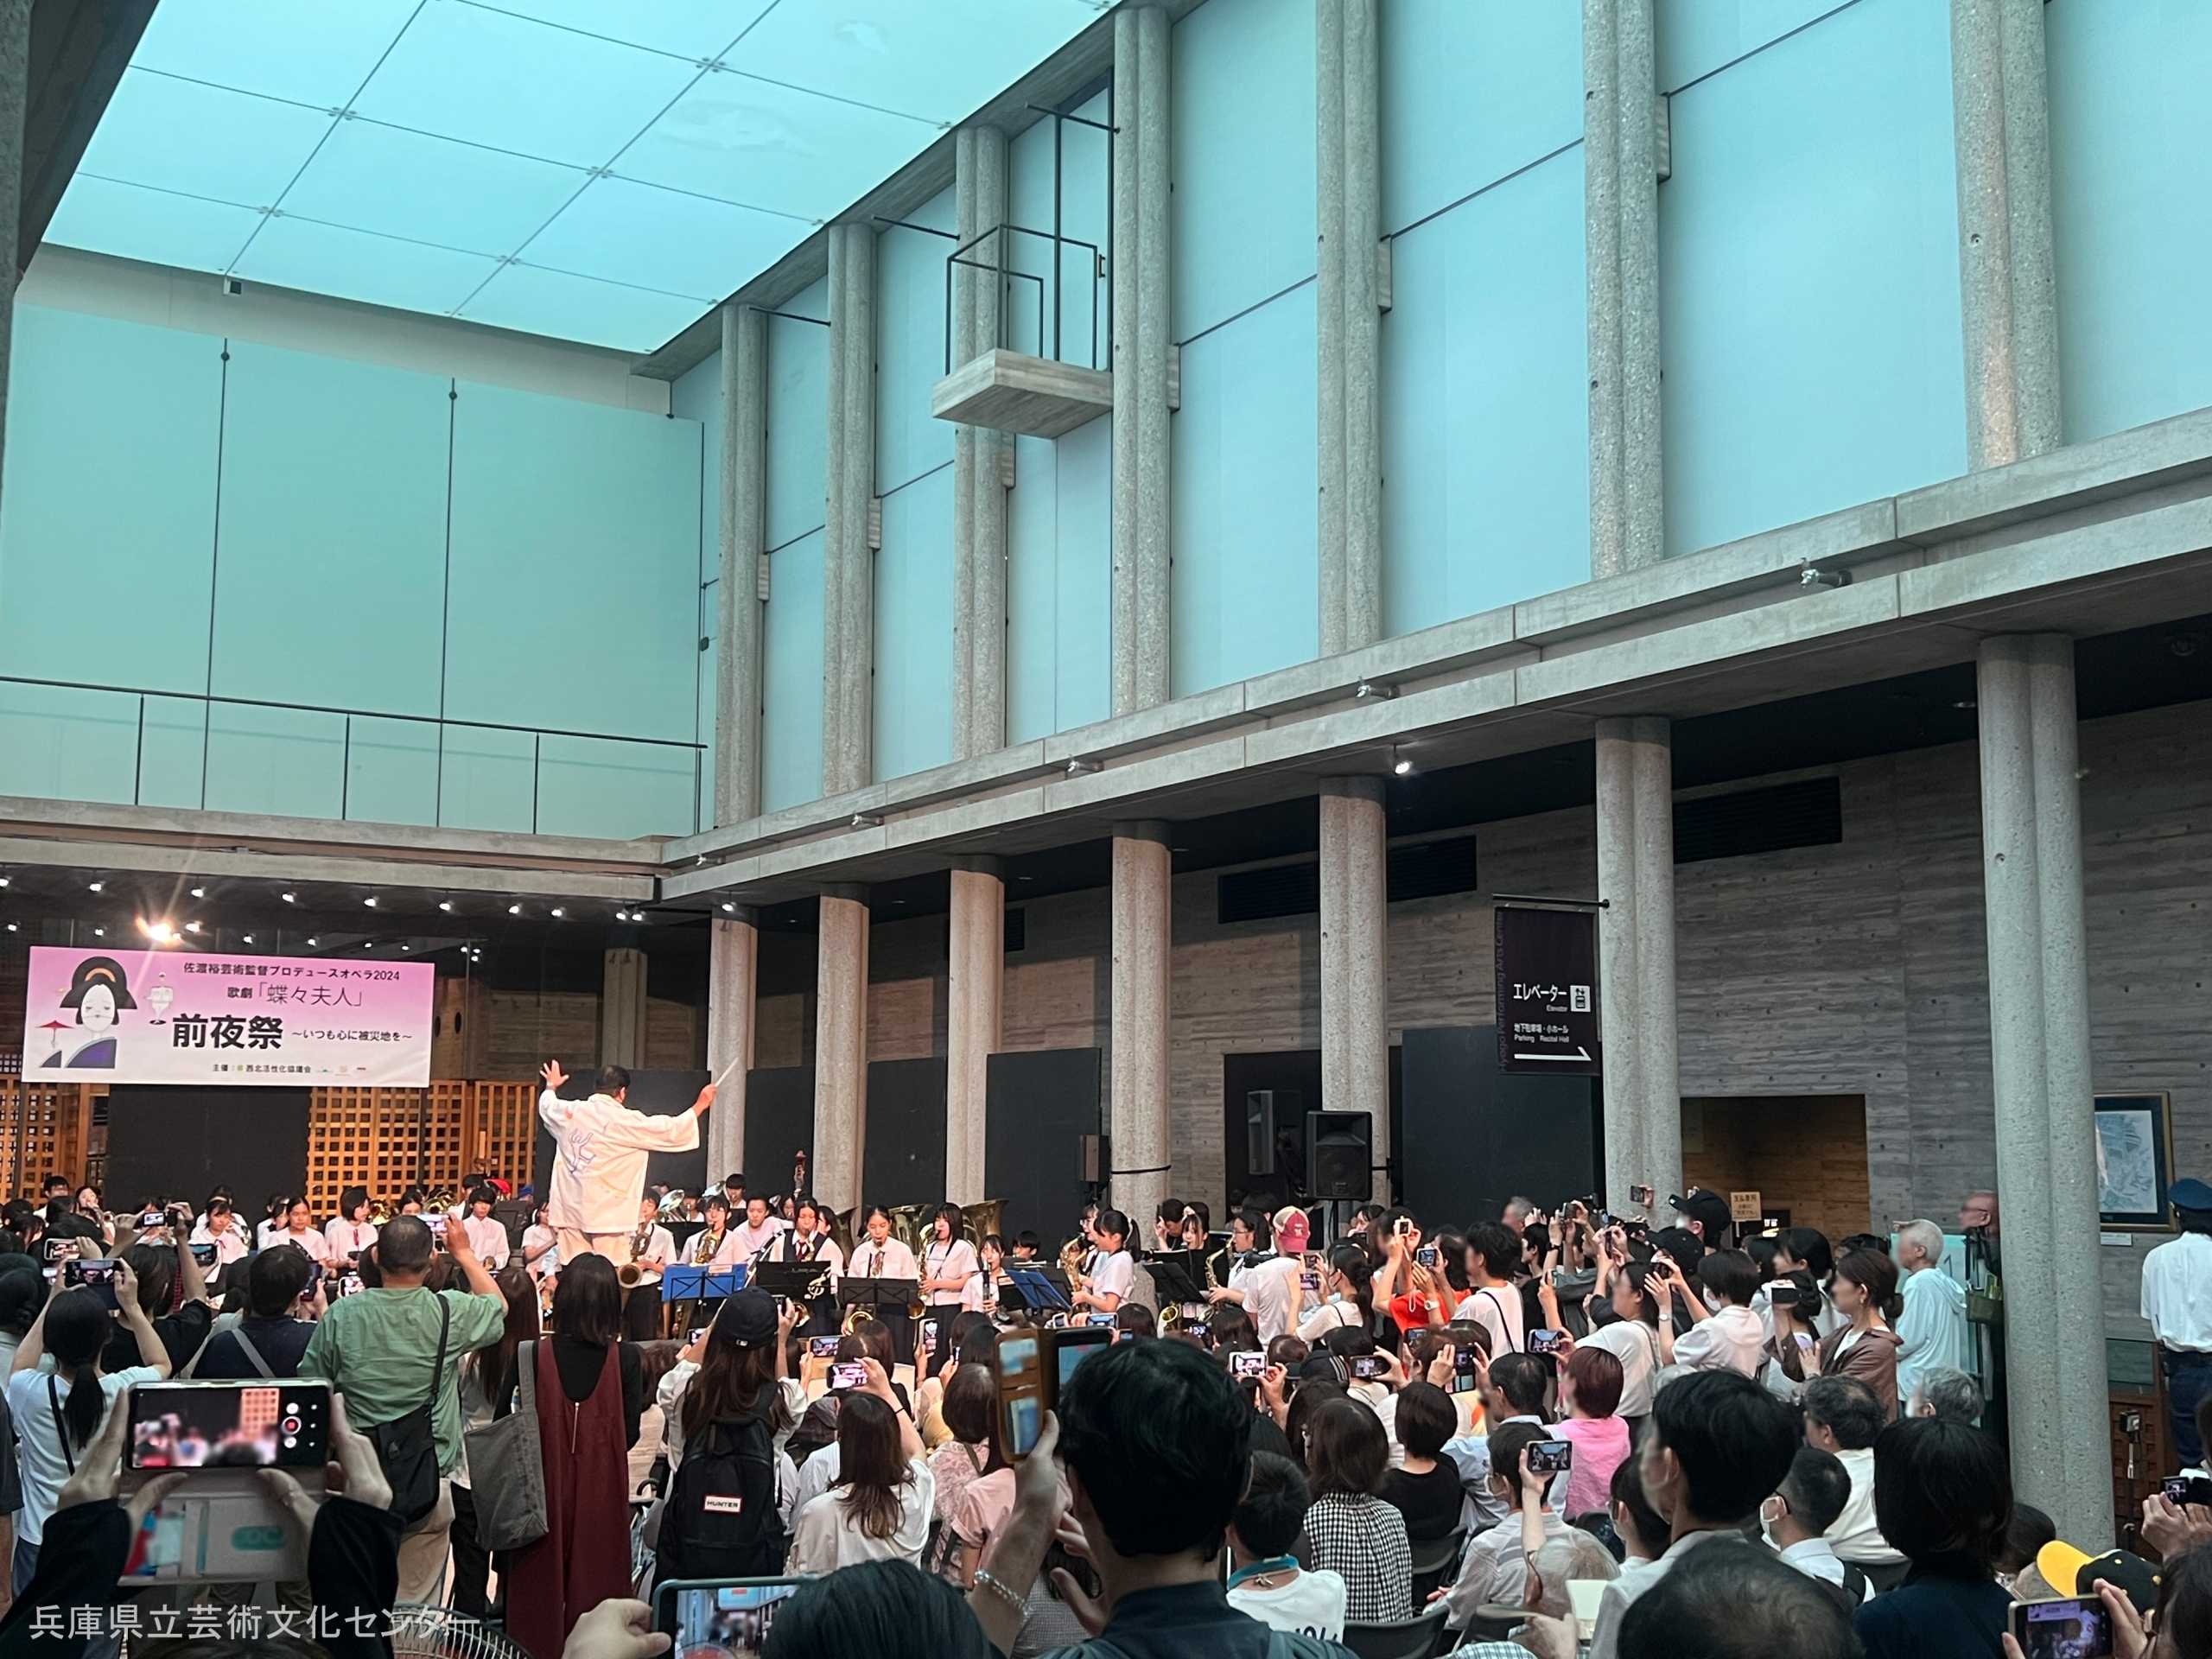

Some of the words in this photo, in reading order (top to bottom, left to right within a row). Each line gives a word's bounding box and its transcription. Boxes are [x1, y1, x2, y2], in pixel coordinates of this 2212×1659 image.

[1497, 973, 1507, 1034] Performing
[1513, 983, 1567, 1002] エレベーター
[172, 1014, 283, 1050] 前夜祭
[1498, 1036, 1509, 1071] Hyogo
